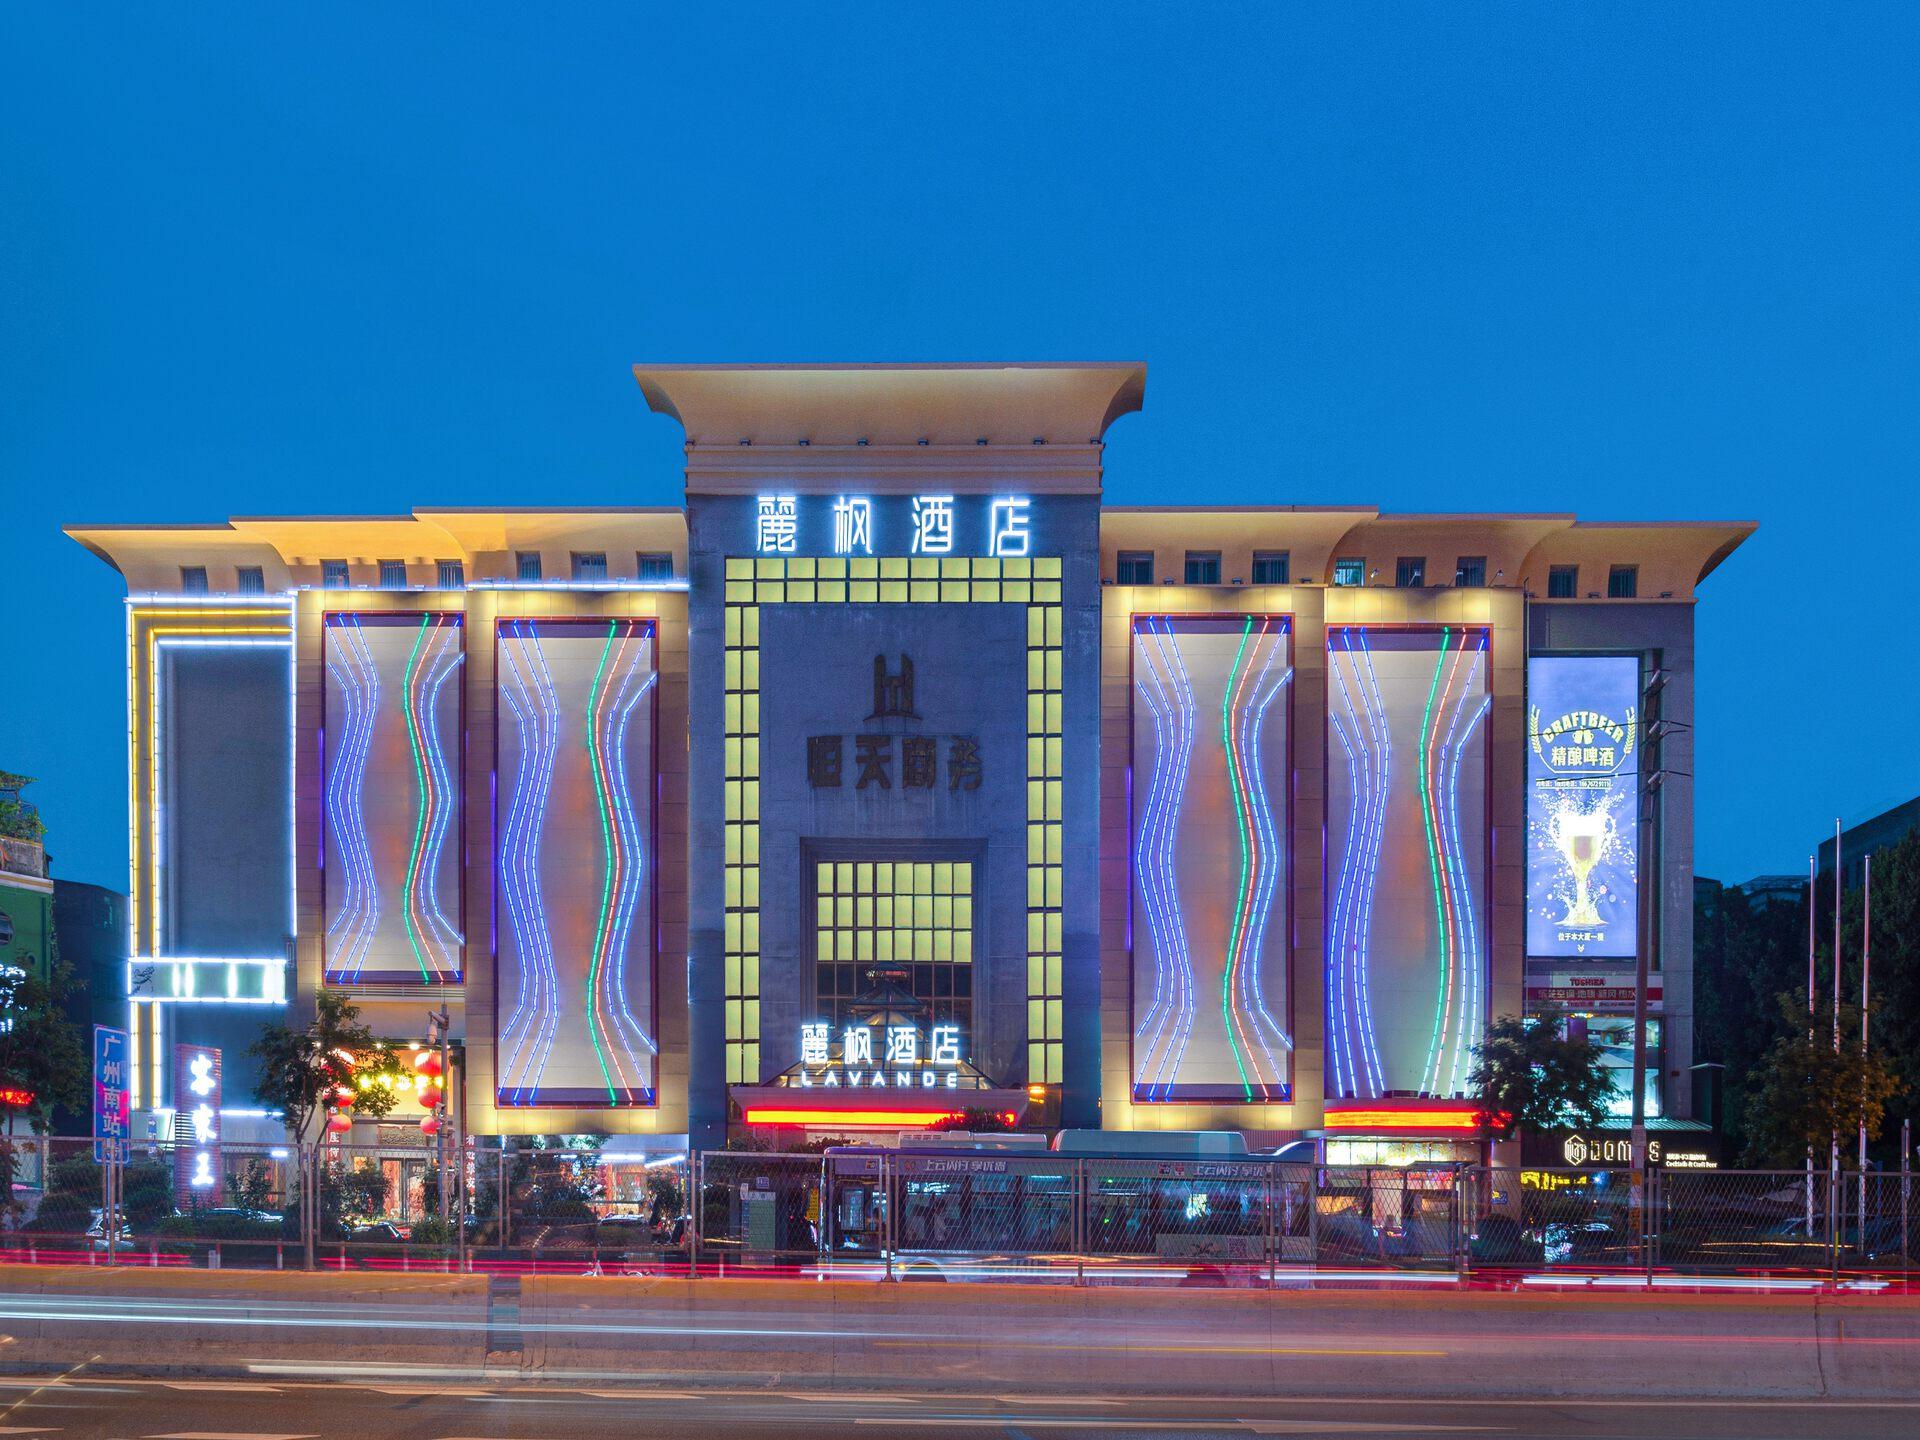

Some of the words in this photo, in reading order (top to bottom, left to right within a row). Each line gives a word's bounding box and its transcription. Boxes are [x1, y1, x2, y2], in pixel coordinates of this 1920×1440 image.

[756, 495, 1031, 557] 麗枫酒店
[1551, 746, 1615, 767] 精酿啤酒
[1569, 976, 1606, 987] TOSHIBA
[800, 1022, 960, 1065] 麗枫酒店
[801, 1070, 958, 1088] LAVANDE
